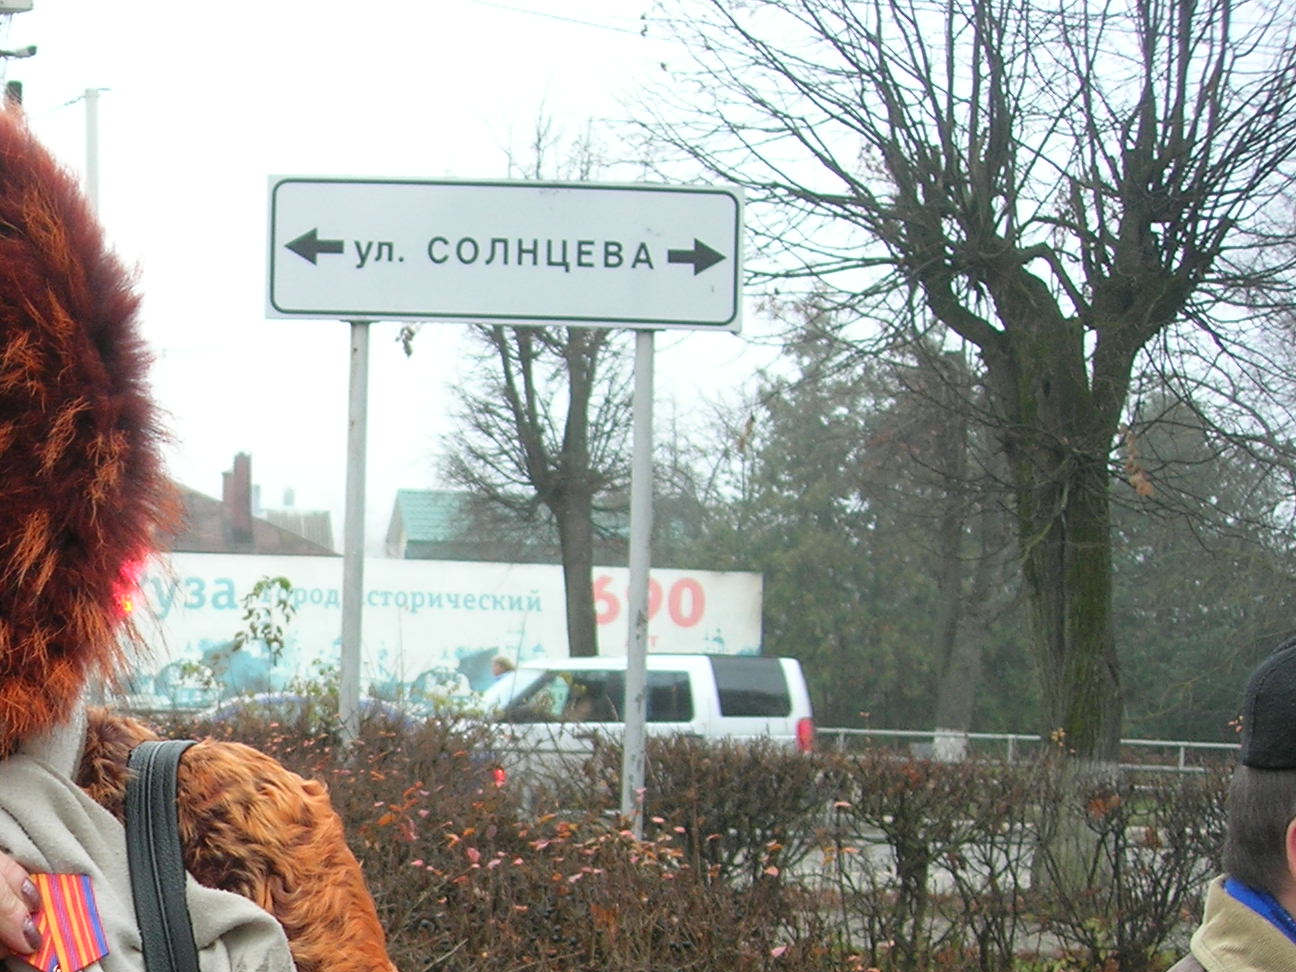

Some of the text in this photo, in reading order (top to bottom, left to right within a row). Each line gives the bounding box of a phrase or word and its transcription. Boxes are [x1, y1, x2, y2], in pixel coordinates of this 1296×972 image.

[354, 236, 654, 272] ул. СОЛНЦЕВА
[143, 574, 239, 620] уза
[362, 589, 544, 615] сторический
